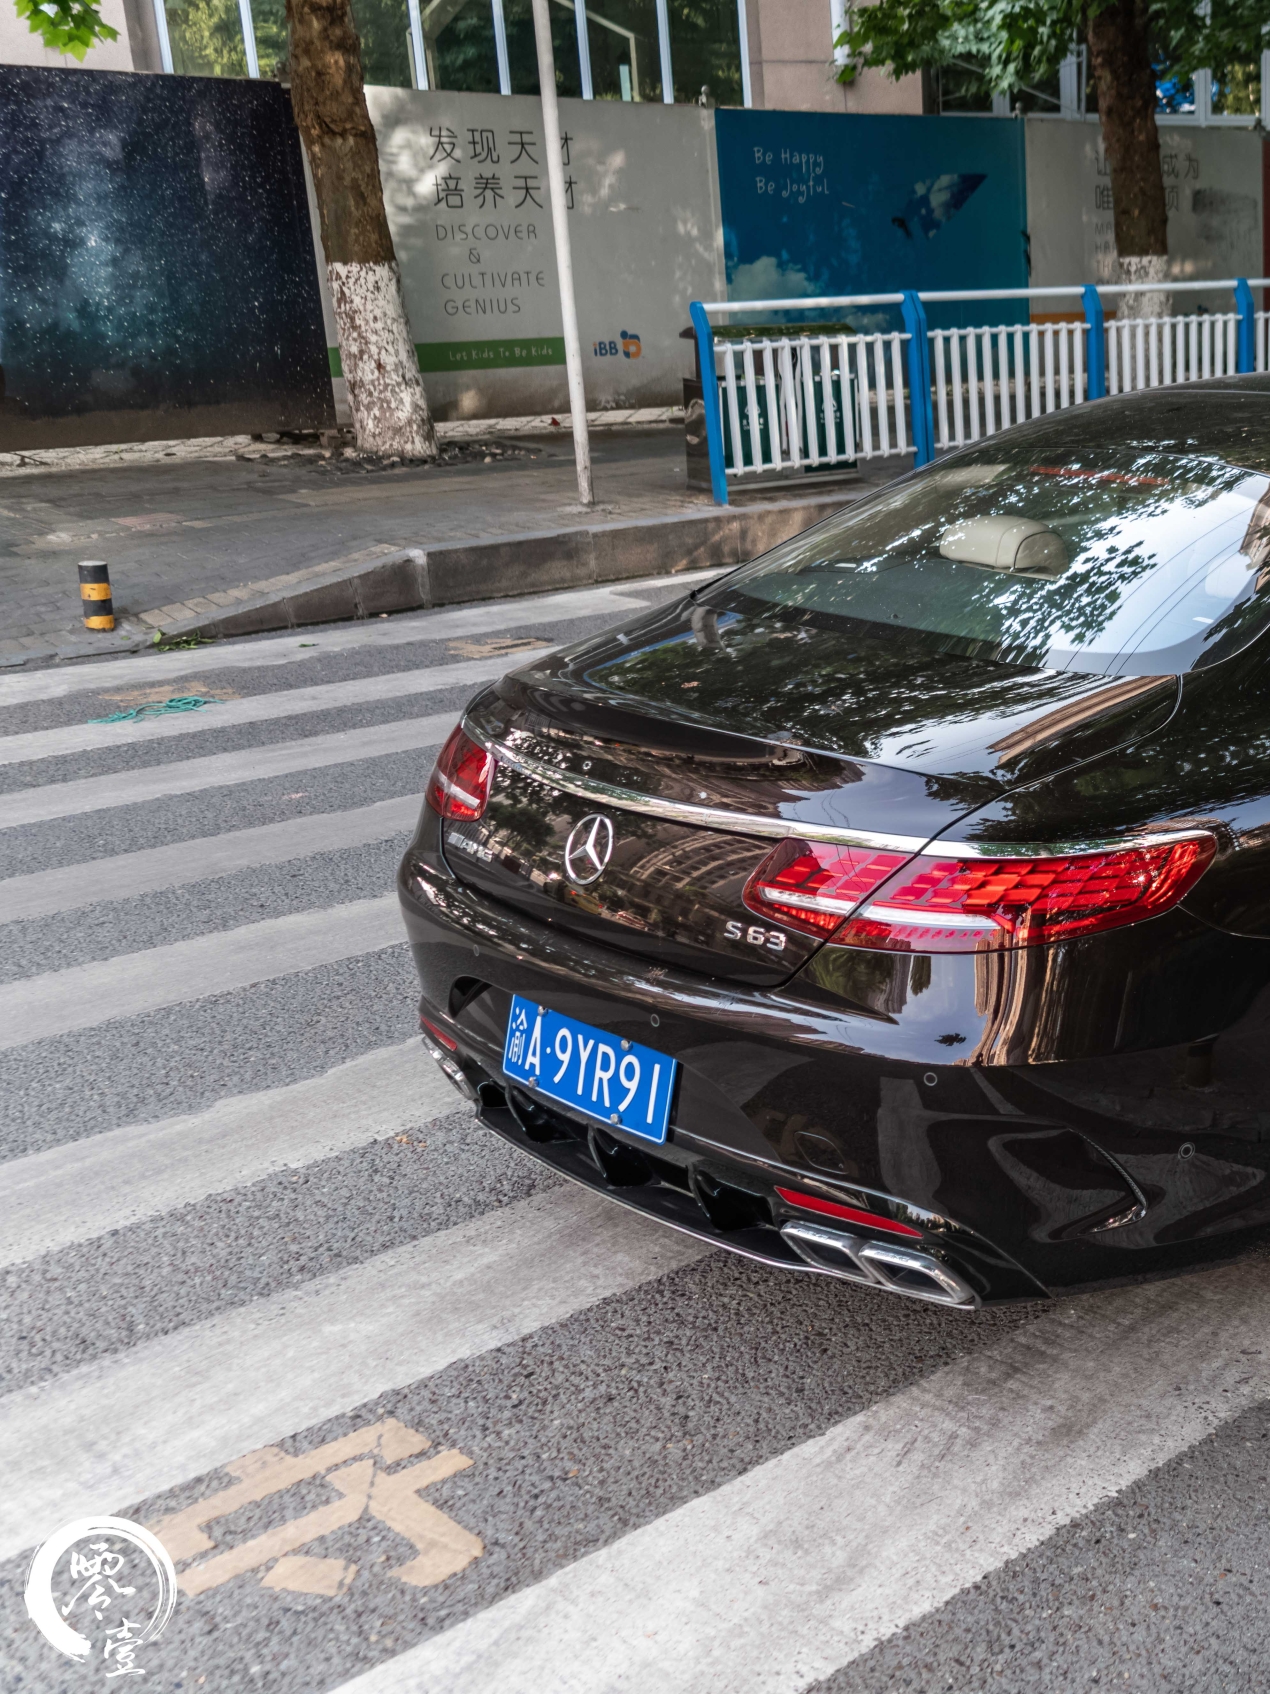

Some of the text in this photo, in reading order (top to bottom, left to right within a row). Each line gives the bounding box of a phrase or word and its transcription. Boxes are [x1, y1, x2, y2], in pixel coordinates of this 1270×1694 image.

[429, 126, 574, 166] 发现天才
[754, 147, 824, 174] Be Happy
[432, 172, 578, 209] 培养天才
[756, 177, 775, 195] Be
[436, 223, 537, 241] DISCOVER
[468, 247, 481, 264] &
[441, 271, 545, 290] CULTIVATE
[444, 297, 521, 316] GENIUS
[450, 345, 553, 361] Let Kids To Be Kids
[593, 341, 619, 357] iBB
